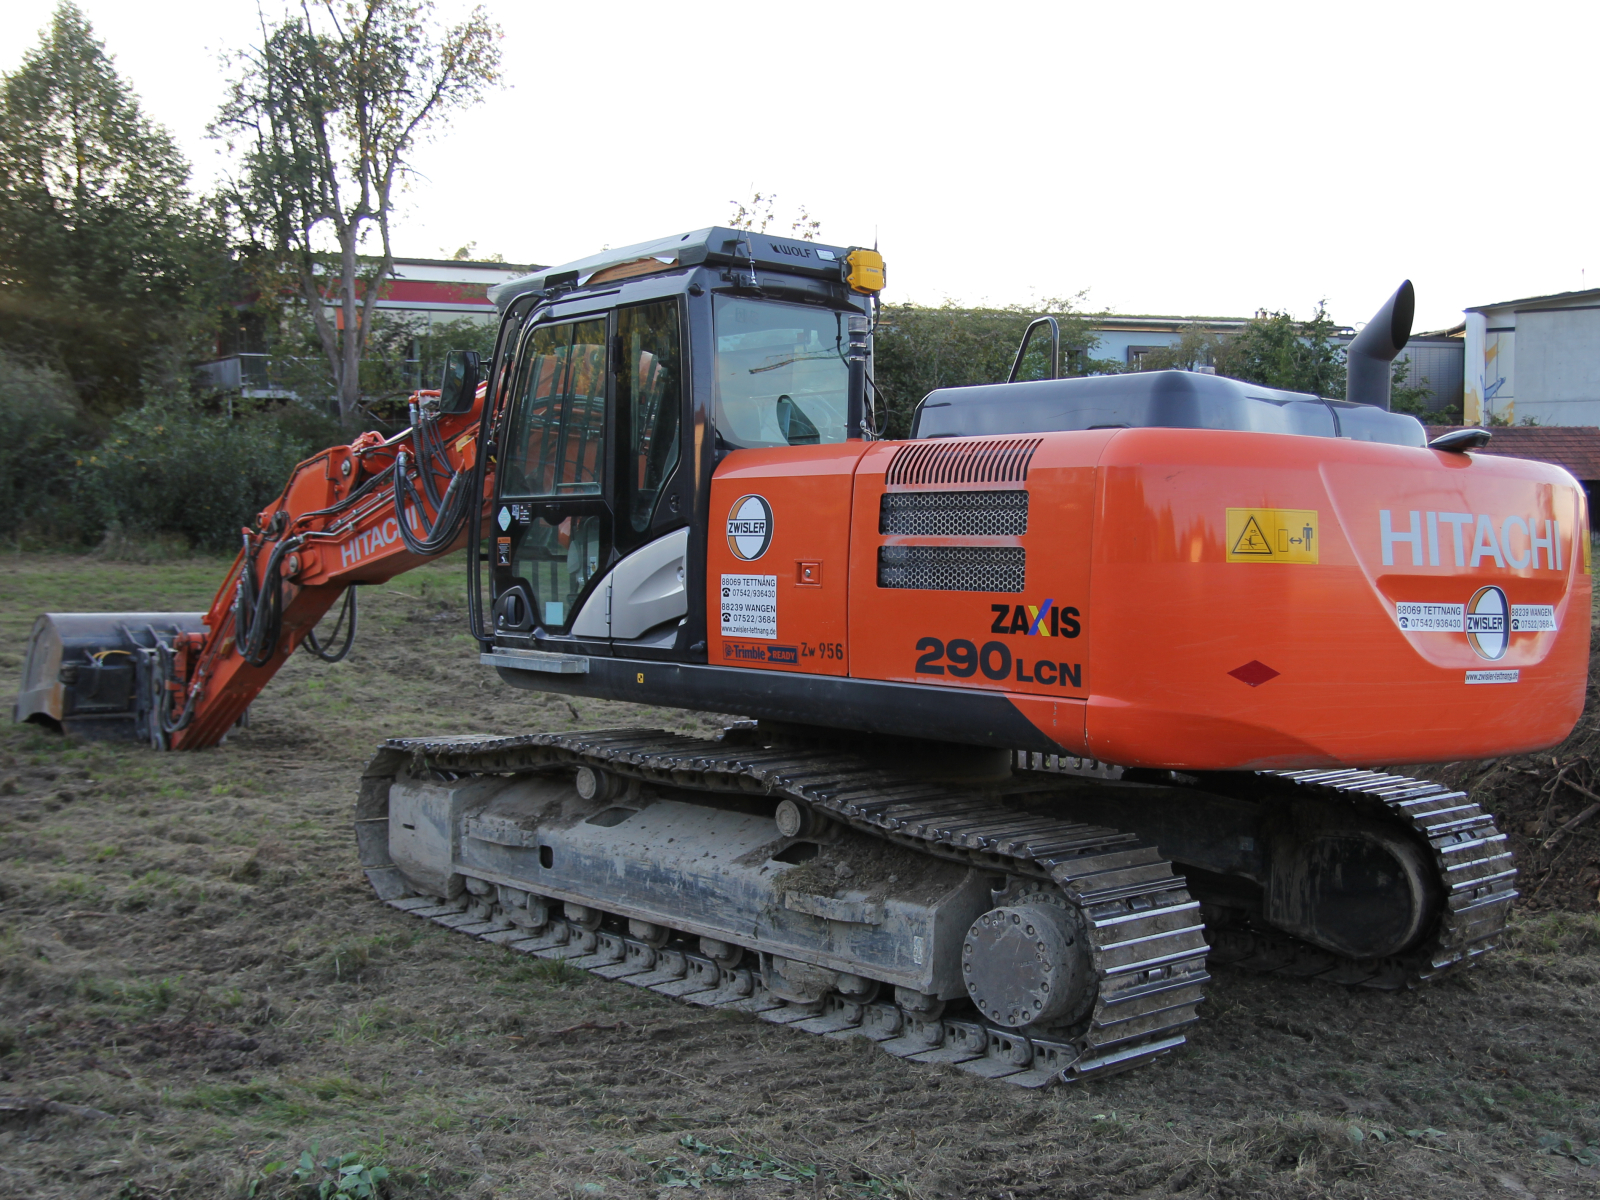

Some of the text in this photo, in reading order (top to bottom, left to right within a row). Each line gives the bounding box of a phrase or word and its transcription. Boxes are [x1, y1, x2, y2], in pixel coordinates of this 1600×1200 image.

[780, 245, 811, 258] WOLF
[728, 522, 765, 534] ZWISLER
[1379, 509, 1562, 571] HITACHI
[721, 578, 776, 587] 88069 TETTNANG
[732, 588, 776, 598] 07542/936430
[721, 602, 776, 613] 88239 WANGEN
[1397, 605, 1461, 616] 88069 TETTNANG
[1511, 607, 1552, 617] 88239 WANGEN
[733, 614, 776, 624] 07522/3684
[991, 598, 1081, 639] ZAXIS
[1410, 618, 1461, 629] 07542/936430
[1467, 617, 1503, 630] ZWISLER
[1520, 619, 1554, 629] 07522/3684
[721, 625, 776, 636] www.zwisler-tettnang.de
[733, 644, 796, 660] Trimble READY
[800, 642, 844, 660] Zw 956
[915, 636, 1082, 688] 290 LCN
[1466, 671, 1518, 682] www.zwisler-tettnang.de
